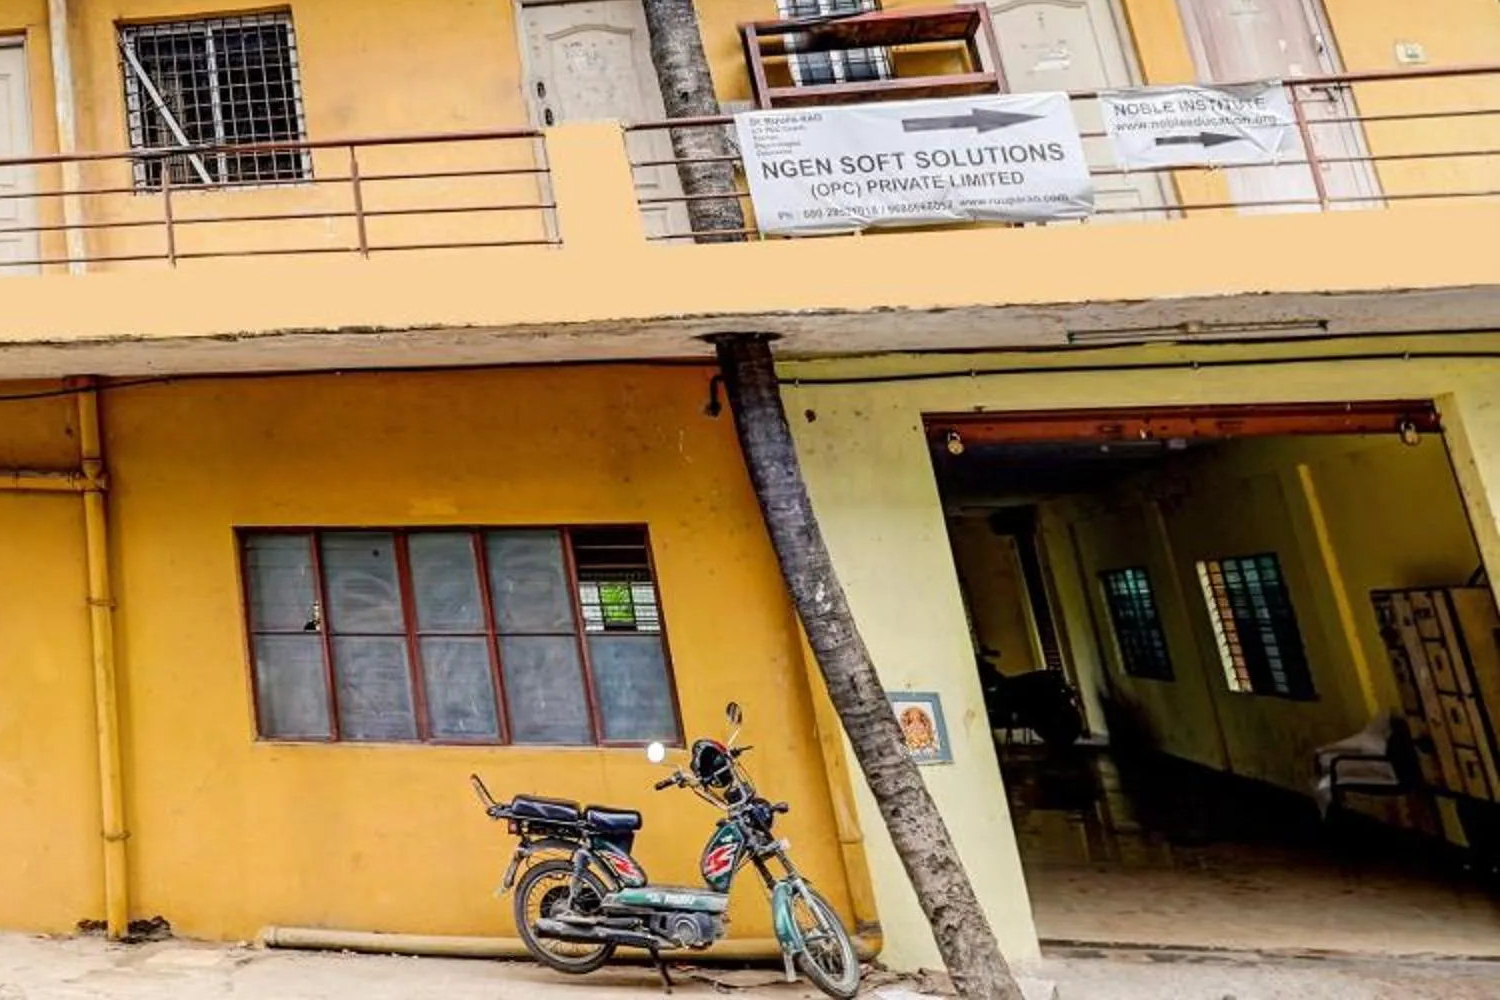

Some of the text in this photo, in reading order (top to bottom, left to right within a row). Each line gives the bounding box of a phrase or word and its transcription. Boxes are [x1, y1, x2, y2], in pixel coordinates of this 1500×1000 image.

[1113, 102, 1174, 117] NOBLE
[761, 143, 1065, 180] NGEN SOFT SOLUTIONS
[811, 171, 1025, 200] (OPC) PRIVATE LIMITED
